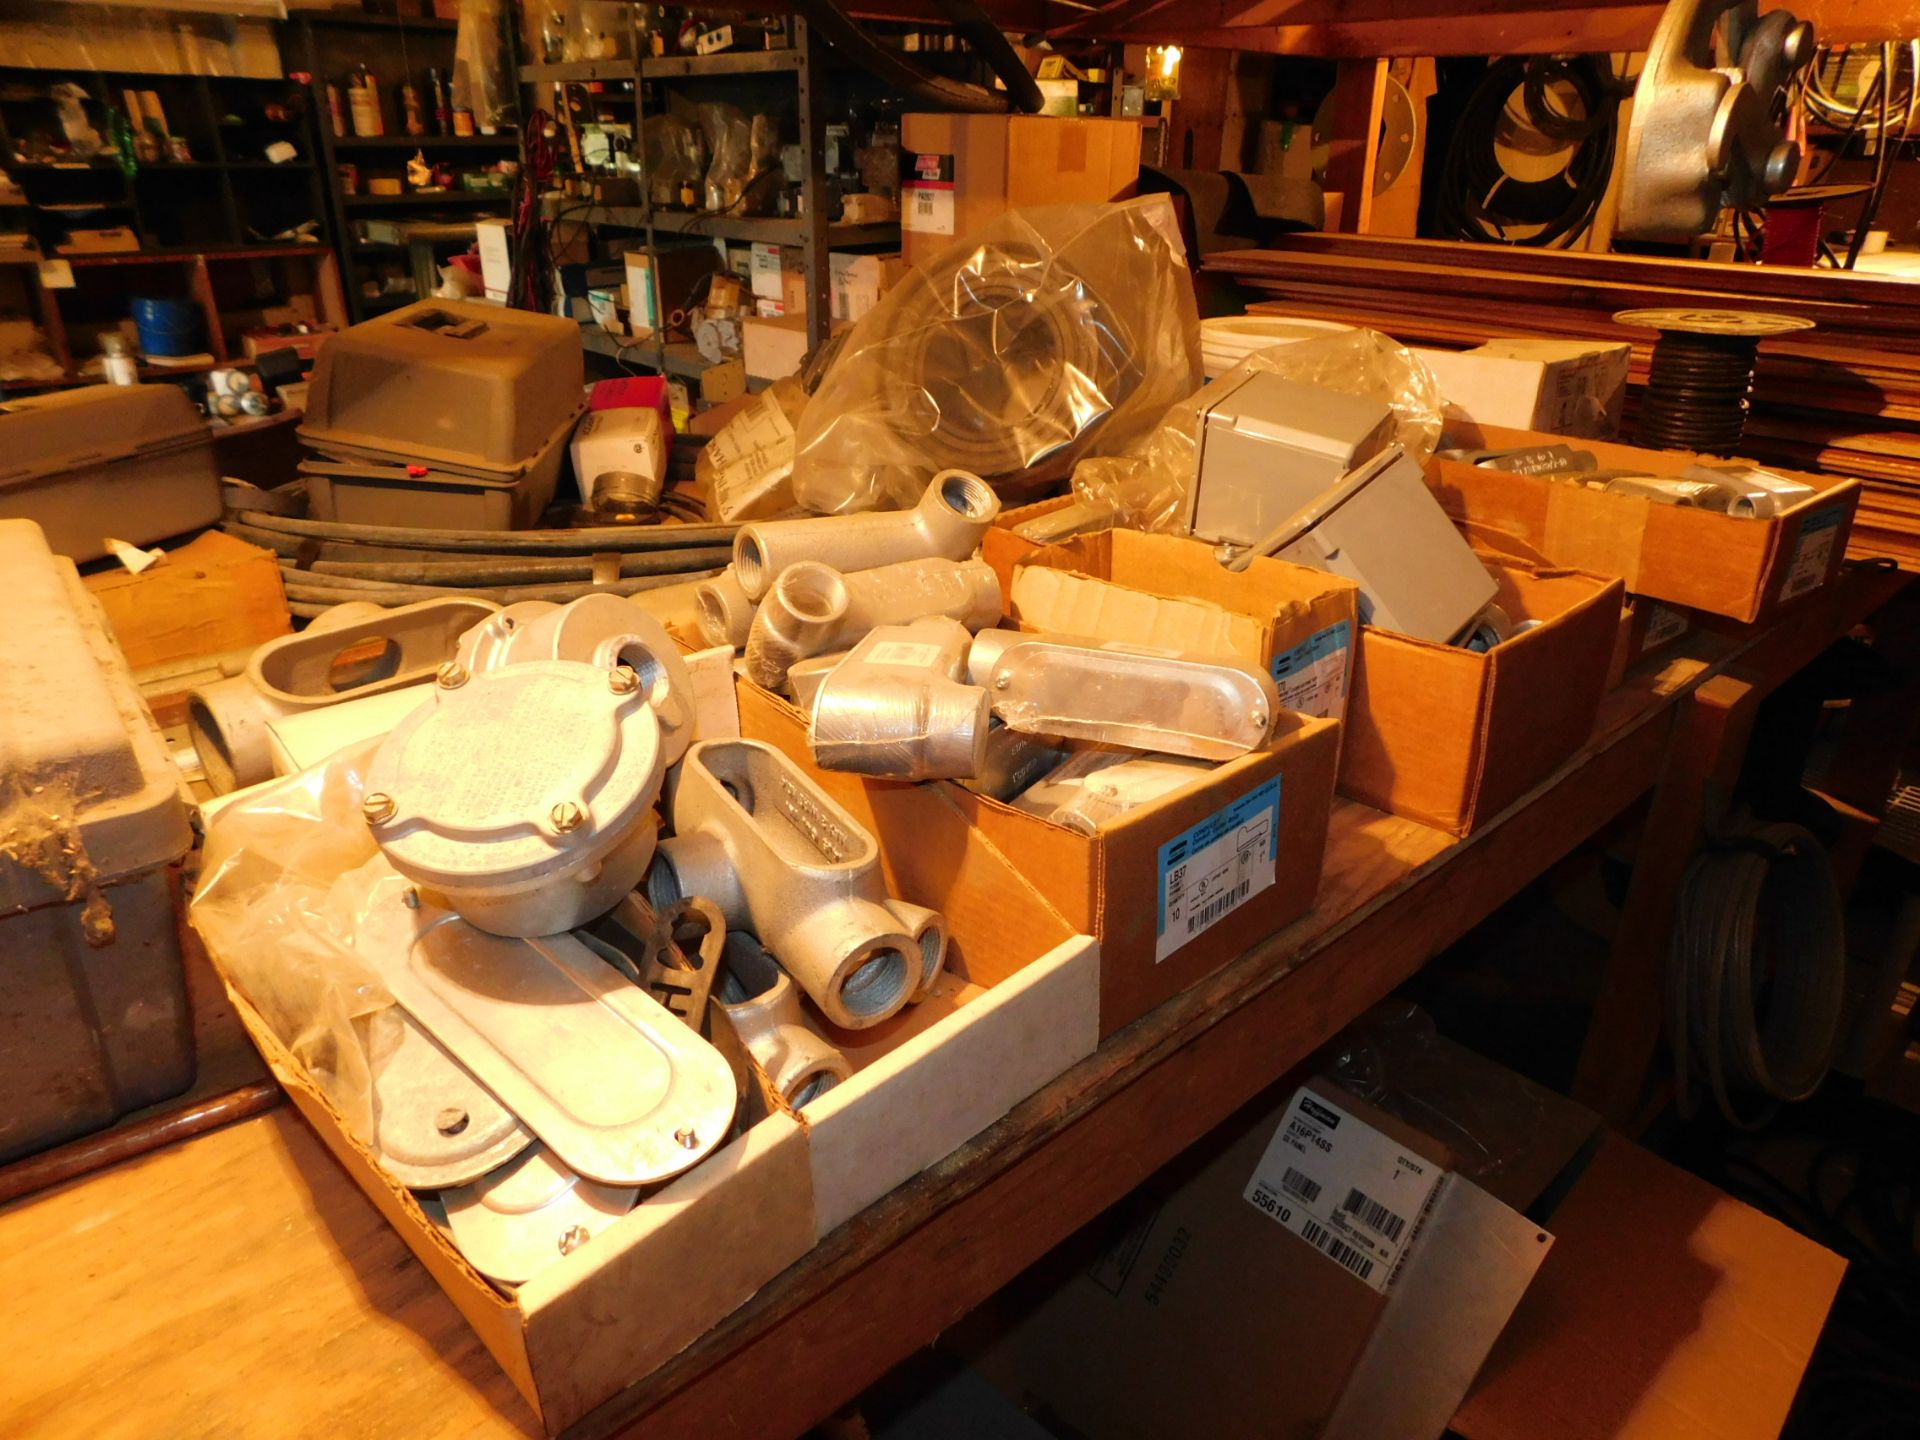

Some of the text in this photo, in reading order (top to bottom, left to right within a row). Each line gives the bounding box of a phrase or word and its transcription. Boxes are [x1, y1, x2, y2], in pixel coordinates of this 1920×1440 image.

[1169, 864, 1187, 885] LB37
[1172, 906, 1181, 922] 10
[1288, 1120, 1333, 1153] A16P14SS
[1252, 1189, 1292, 1223] 55610
